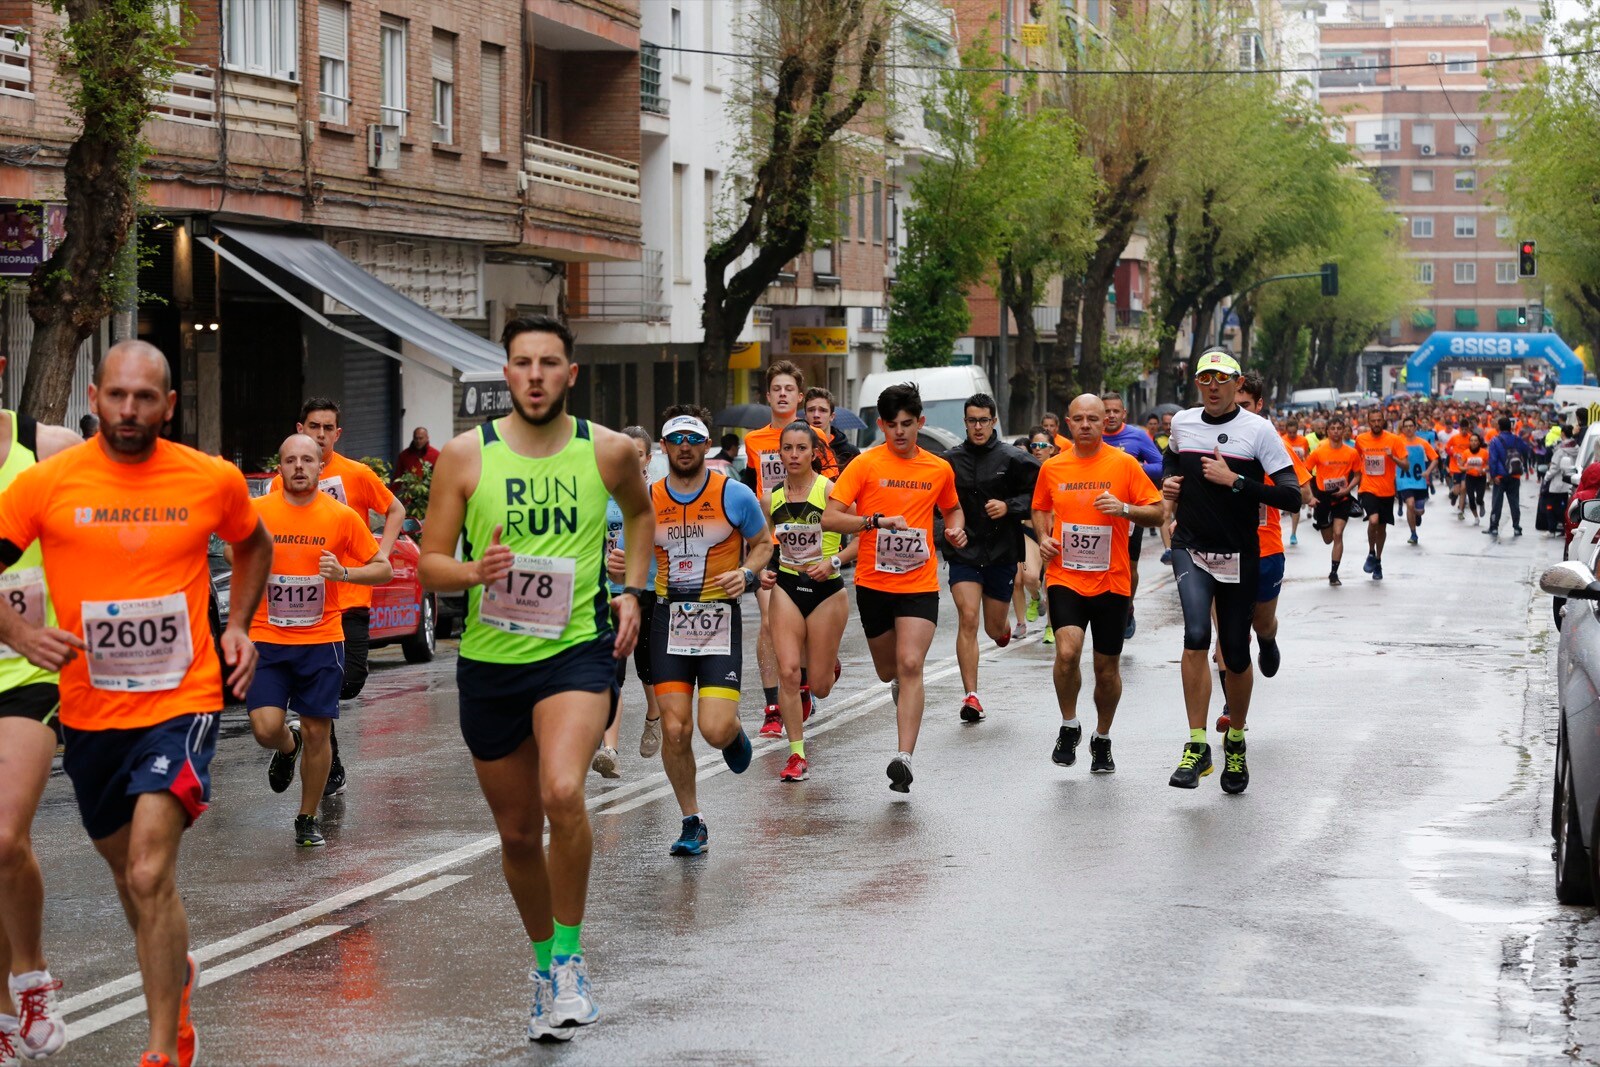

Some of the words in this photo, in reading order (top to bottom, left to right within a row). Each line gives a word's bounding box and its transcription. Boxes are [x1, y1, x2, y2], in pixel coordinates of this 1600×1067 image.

[506, 476, 577, 505] RUN
[887, 479, 932, 490] MARCELINO
[1065, 481, 1111, 491] MARCELINO
[94, 507, 189, 523] MARCELINO
[506, 507, 577, 536] RUN
[667, 522, 704, 540] ROLDÁN
[273, 534, 326, 546] MARCELINO
[884, 536, 924, 553] 1372
[1071, 534, 1101, 550] 357
[517, 555, 553, 567] OXIMESA
[506, 570, 553, 599] 178
[273, 585, 318, 602] 2112
[516, 597, 540, 608] MARIO
[676, 613, 724, 630] 2767
[96, 615, 178, 649] 2605
[109, 649, 143, 659] ROBERTO
[145, 646, 173, 658] CARLOS
